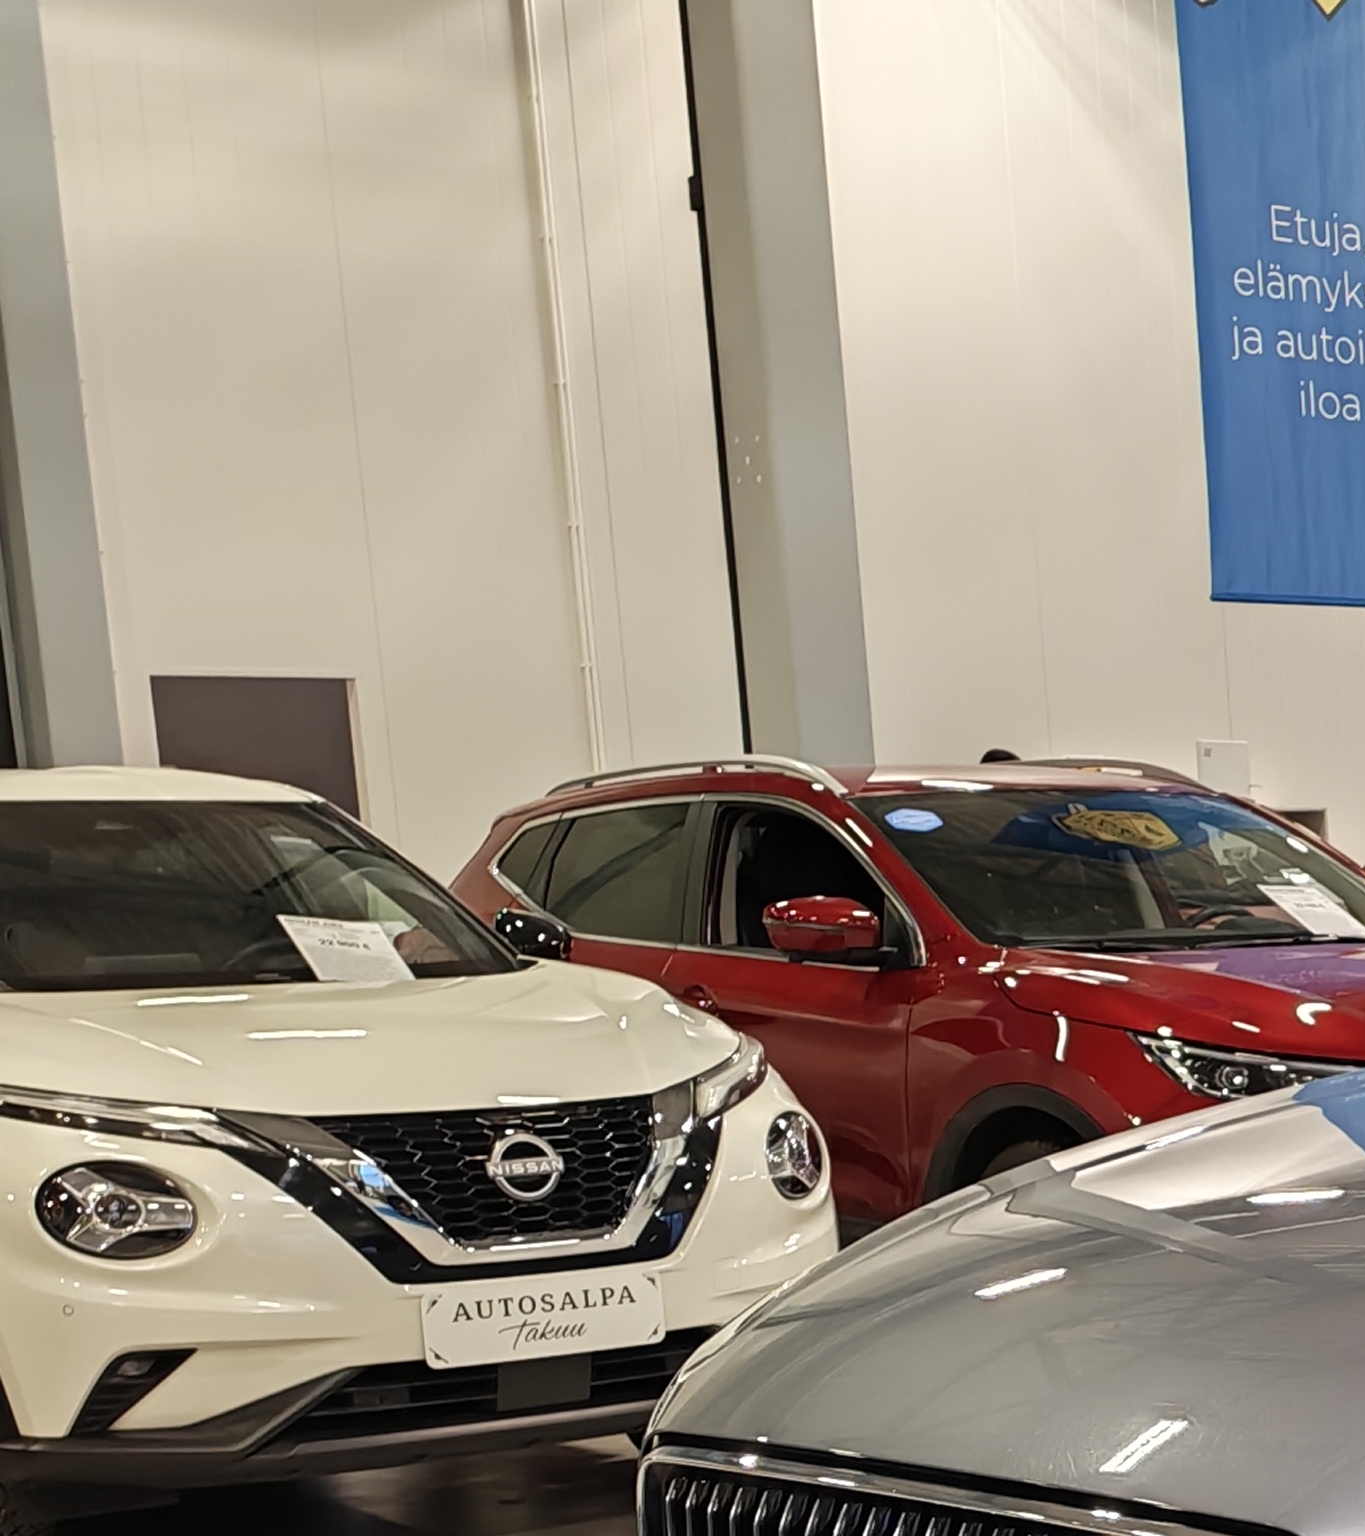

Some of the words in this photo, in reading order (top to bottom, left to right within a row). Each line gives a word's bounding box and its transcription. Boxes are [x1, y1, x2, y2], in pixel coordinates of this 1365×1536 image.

[1231, 315, 1263, 361] ja
[1299, 379, 1362, 422] iloa
[488, 1159, 564, 1177] NISSAN
[452, 1284, 637, 1323] AUTOSALPA
[498, 1319, 588, 1351] Takuu
